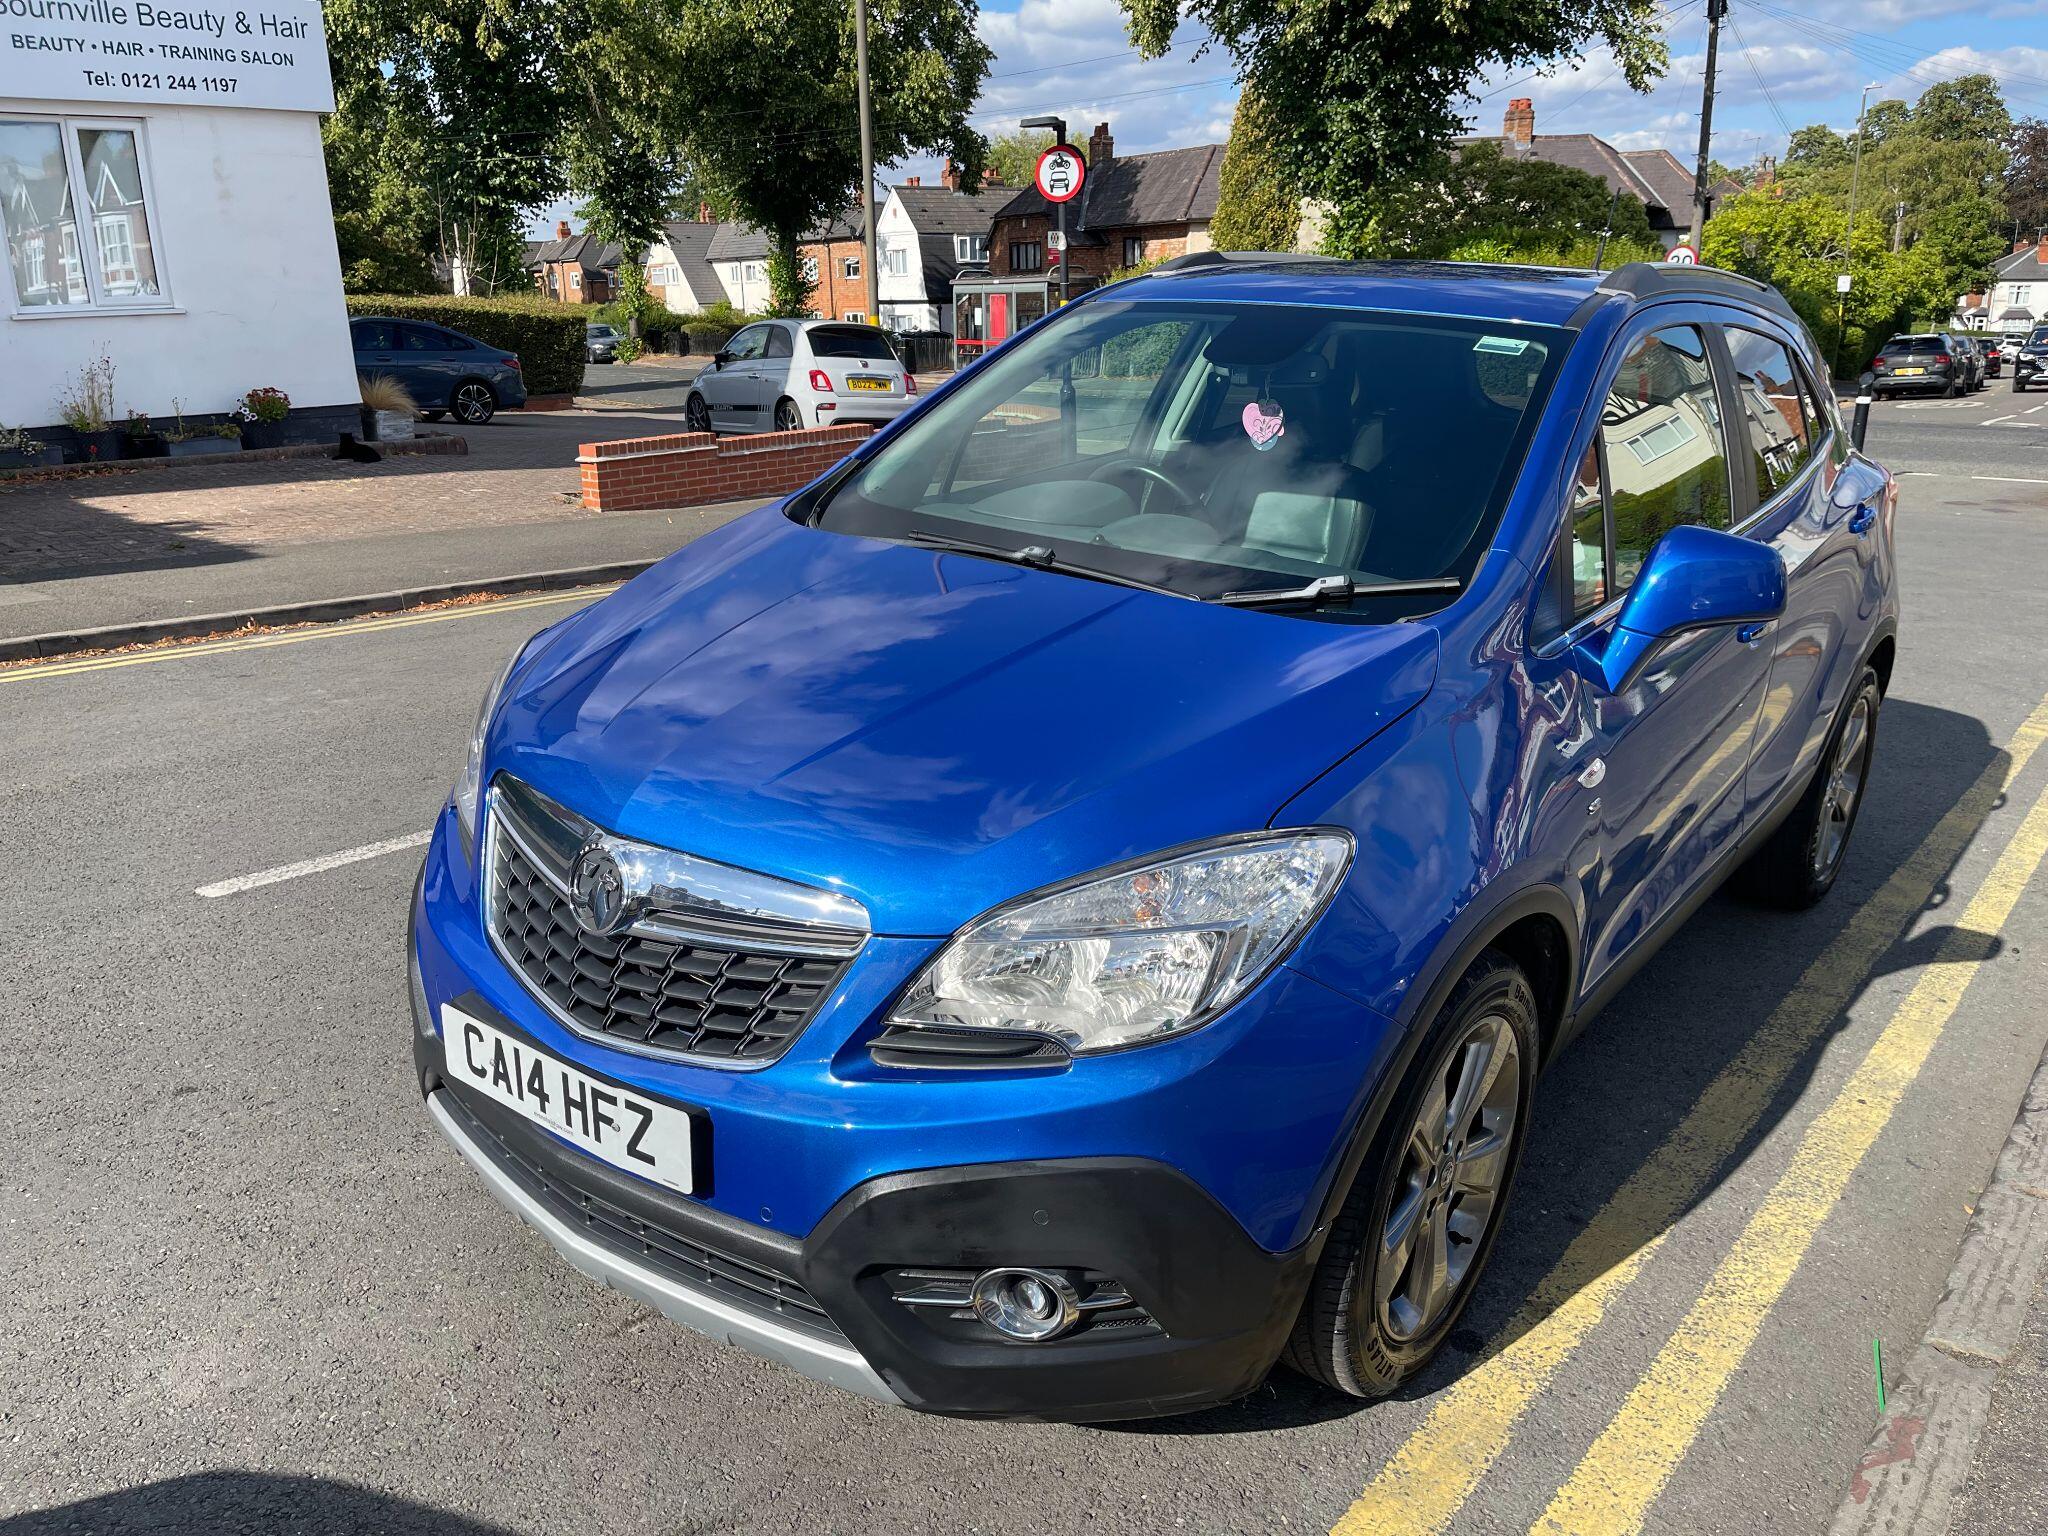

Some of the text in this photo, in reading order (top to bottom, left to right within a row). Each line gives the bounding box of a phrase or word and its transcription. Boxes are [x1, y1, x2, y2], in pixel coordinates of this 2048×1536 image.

[136, 2, 225, 38] Beauty
[235, 11, 252, 34] &
[260, 13, 308, 39] Hair
[11, 34, 294, 66] BEAUTY HAIR TRAINING SALON
[83, 70, 238, 93] Tel: 0121 244 1197
[463, 1022, 656, 1167] CA14 HFZ
